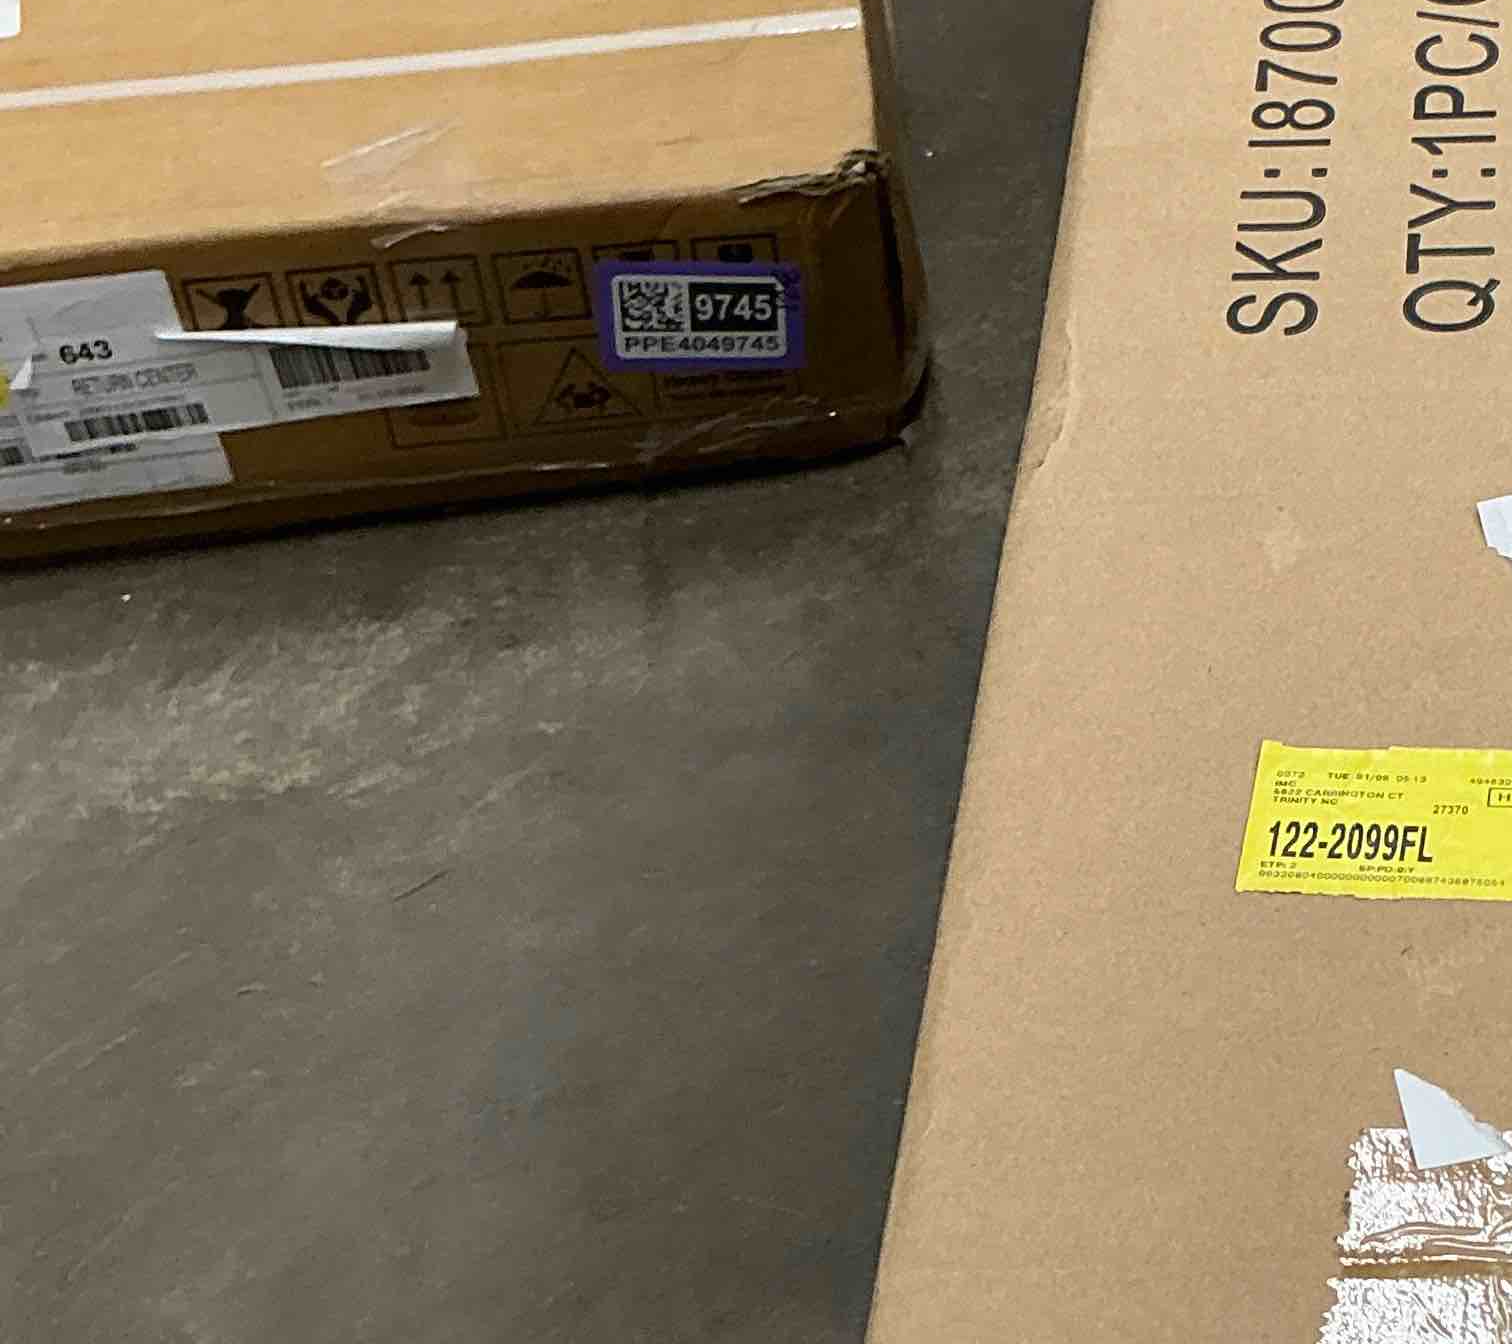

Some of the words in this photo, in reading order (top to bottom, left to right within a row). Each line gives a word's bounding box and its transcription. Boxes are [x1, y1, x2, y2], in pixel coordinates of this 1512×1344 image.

[695, 294, 772, 321] 9745
[59, 340, 113, 365] 643
[624, 336, 780, 353] PPE4049745
[1273, 796, 1317, 805] TRINITY
[1432, 804, 1469, 815] 27370
[1268, 820, 1434, 864] 122-2099FL
